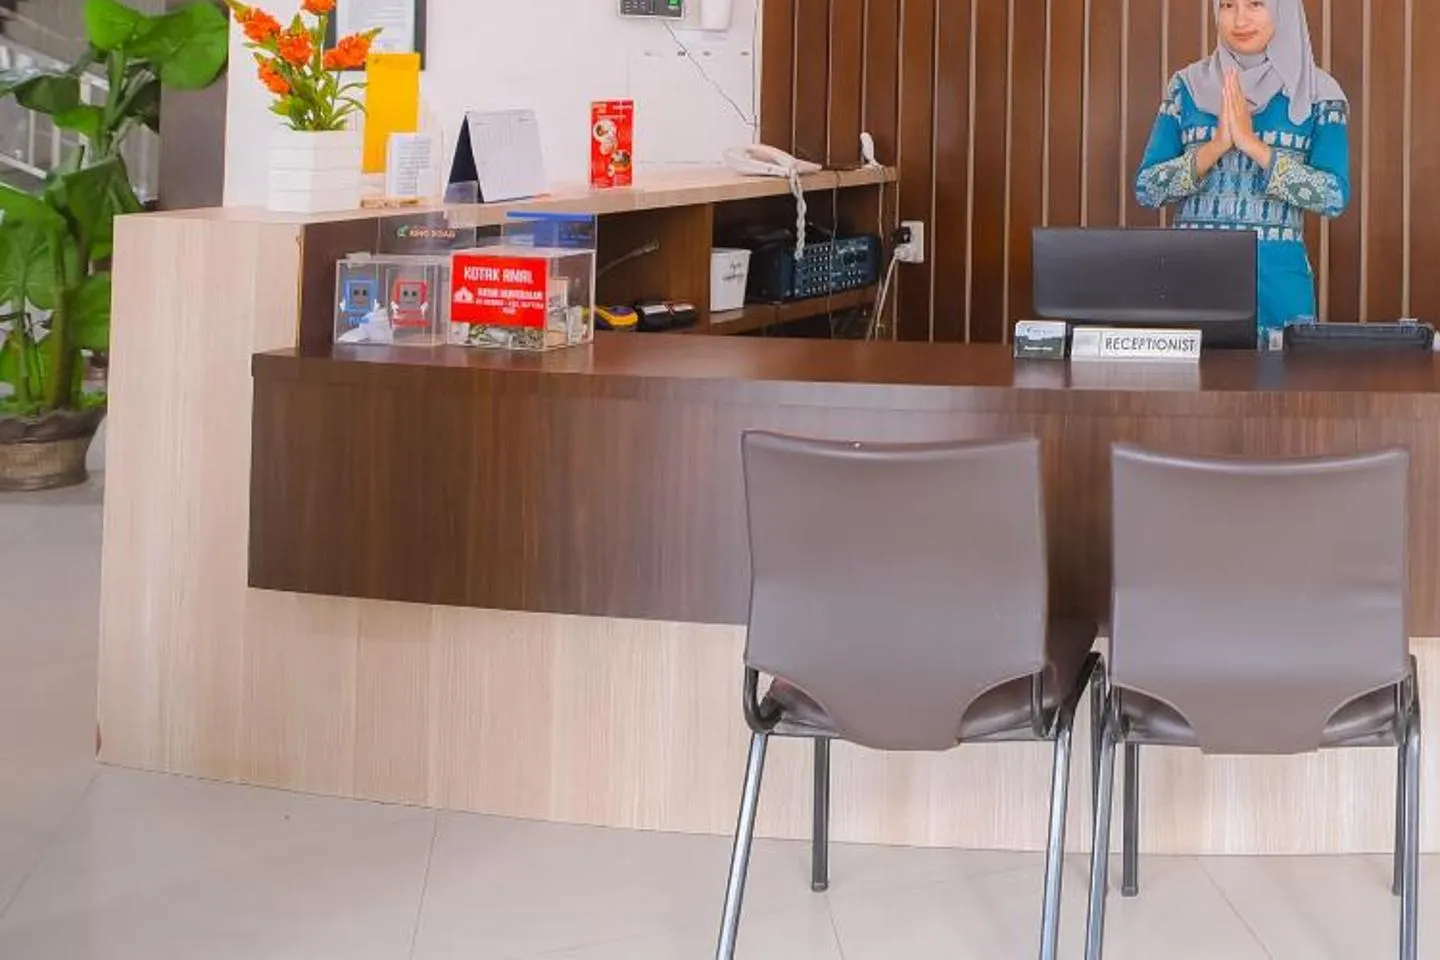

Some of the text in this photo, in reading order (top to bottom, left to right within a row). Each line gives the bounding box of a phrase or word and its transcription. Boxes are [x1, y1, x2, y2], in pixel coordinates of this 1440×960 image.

[464, 266, 534, 284] KOTAK AMAL
[1105, 337, 1196, 352] RECEPTIONIST
